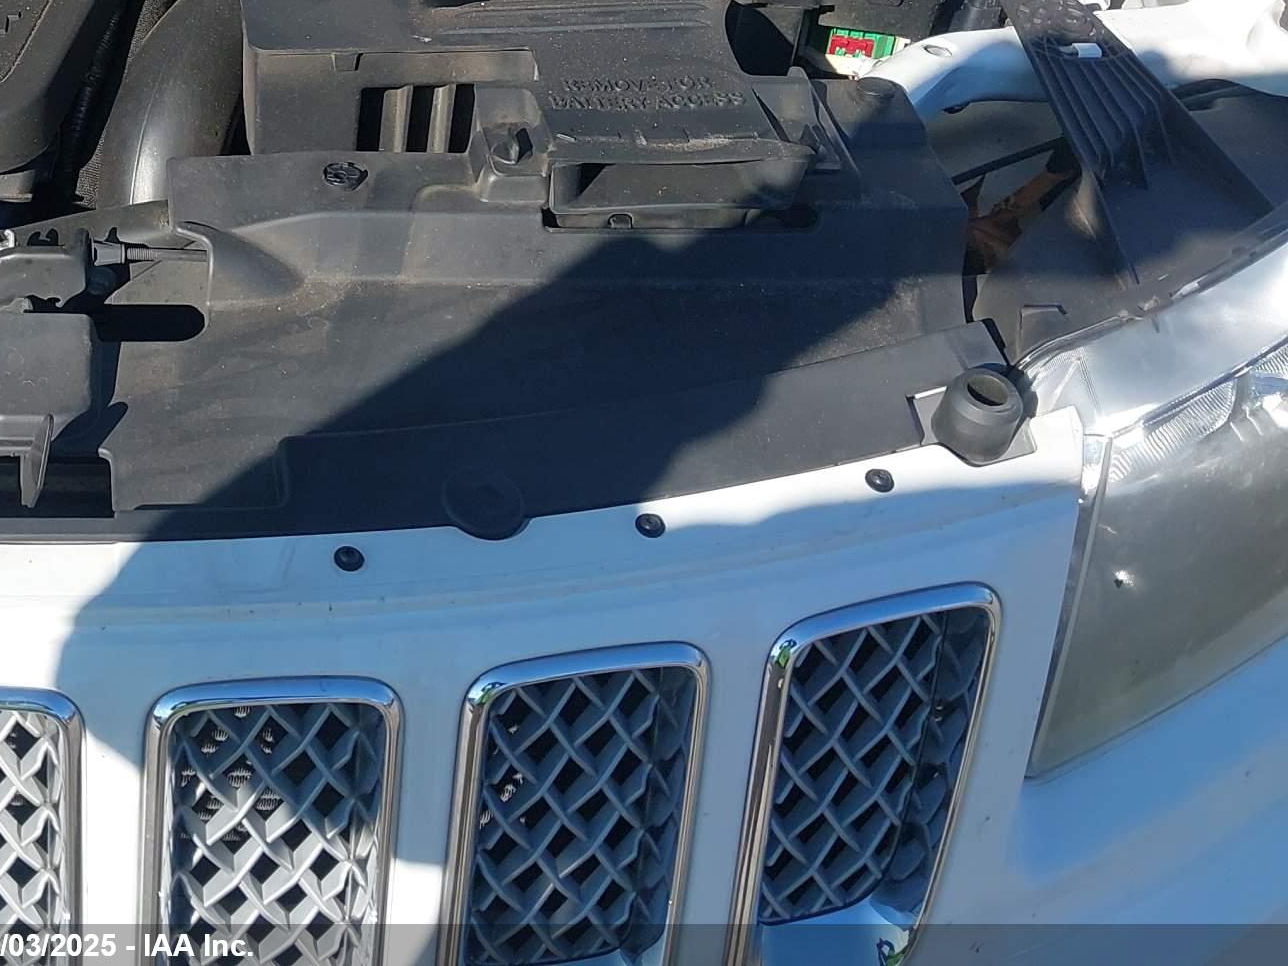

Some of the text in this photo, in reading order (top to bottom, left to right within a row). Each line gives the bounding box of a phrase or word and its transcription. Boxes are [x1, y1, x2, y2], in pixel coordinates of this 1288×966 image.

[563, 76, 656, 92] REMOVE
[548, 91, 746, 112] BATTERY ACCESS
